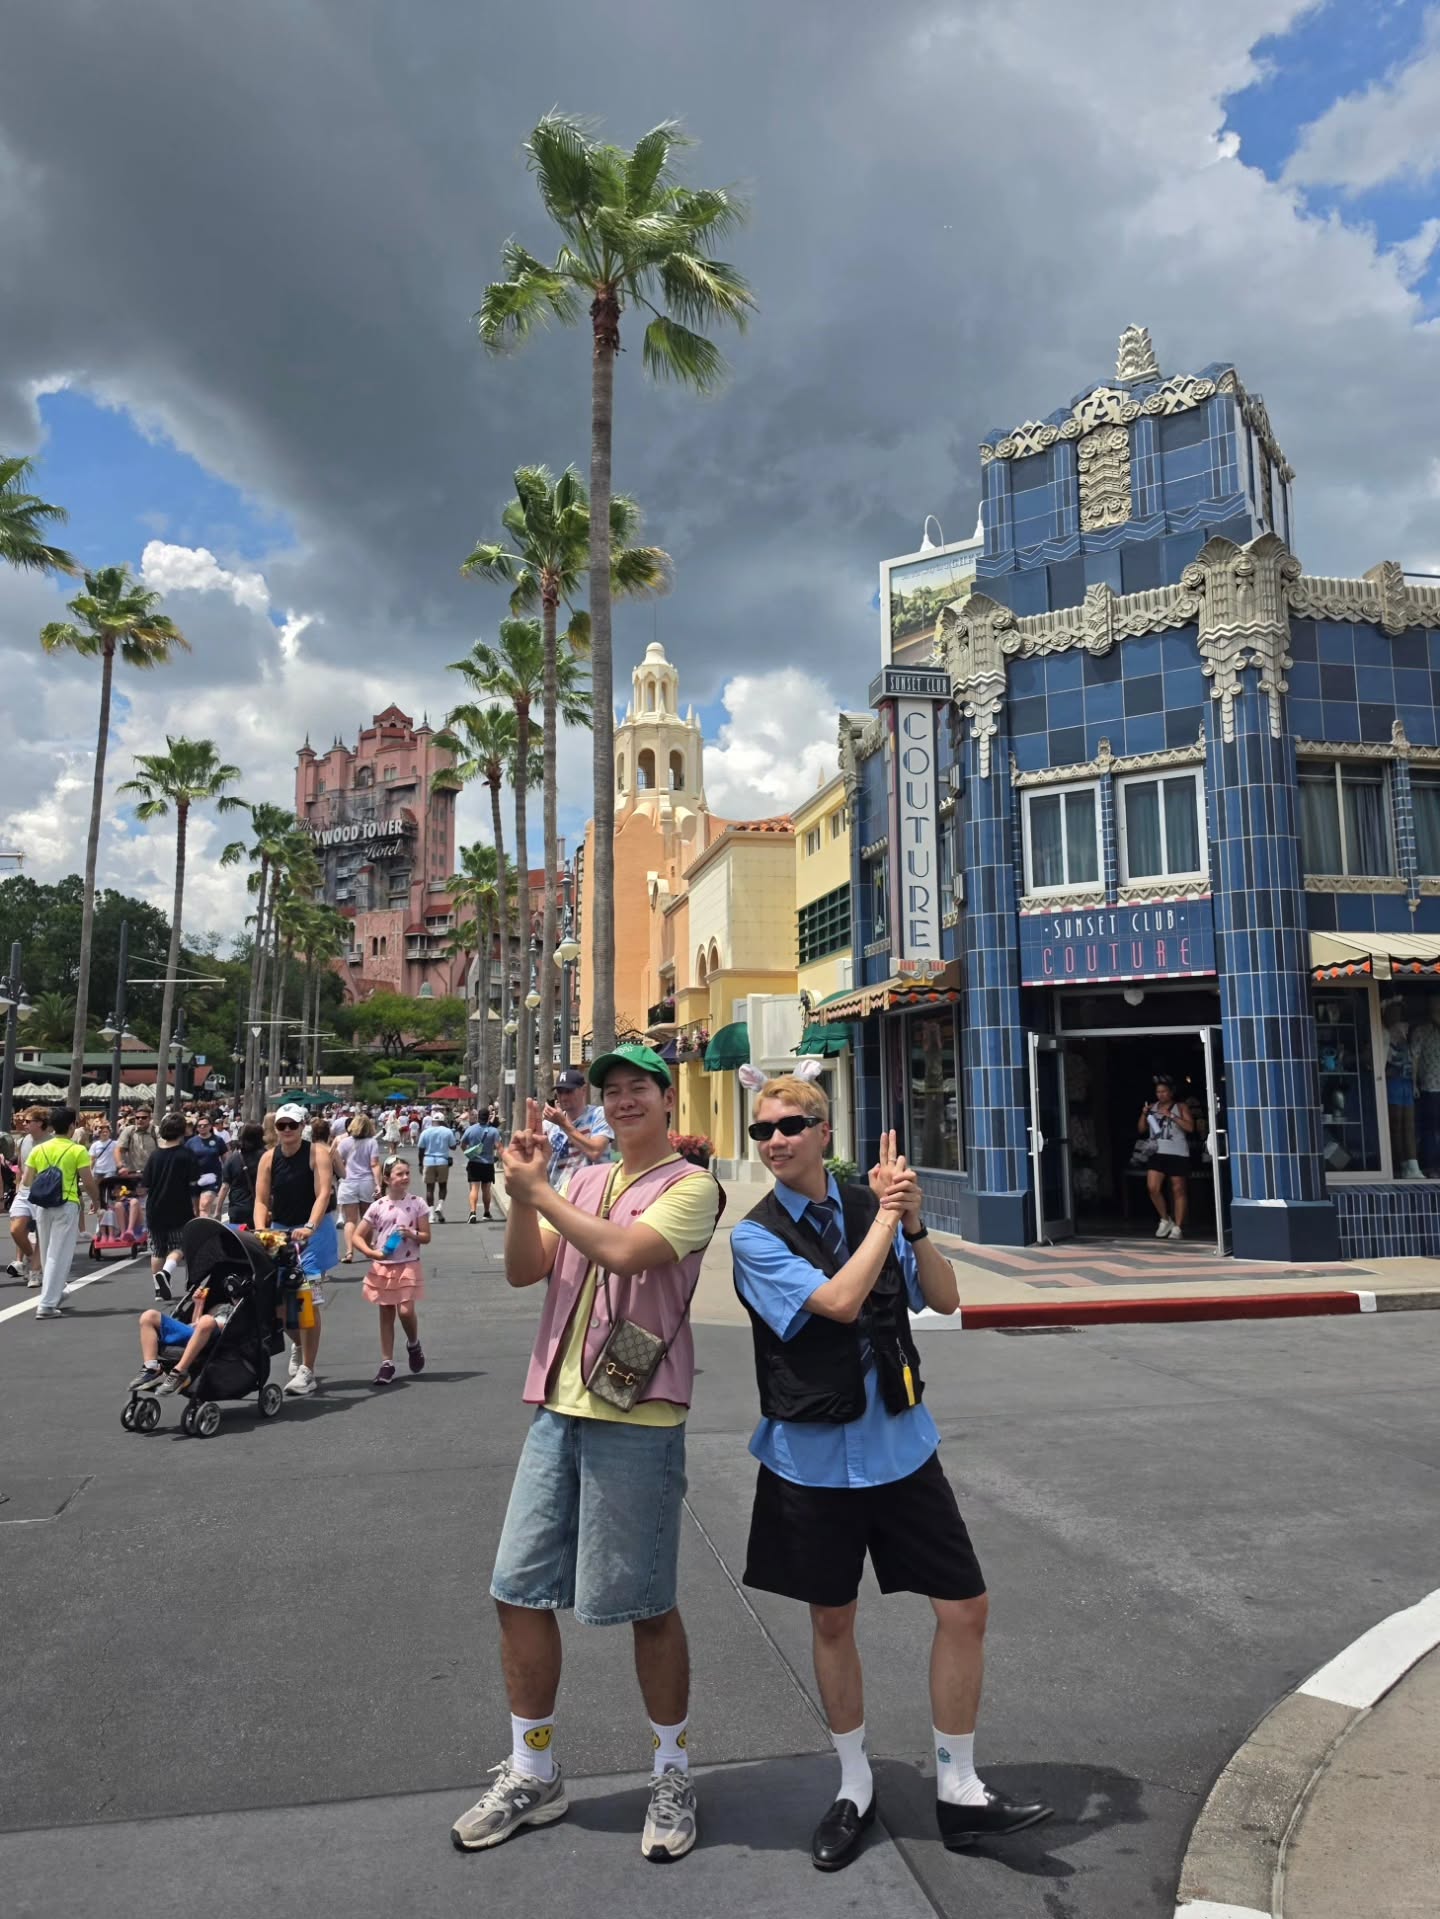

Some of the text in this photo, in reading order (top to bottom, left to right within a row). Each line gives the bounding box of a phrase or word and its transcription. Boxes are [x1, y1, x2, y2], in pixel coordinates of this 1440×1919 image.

[890, 675, 947, 692] SUNSET CLUB
[362, 819, 403, 839] TOWER
[903, 712, 931, 947] COUTURE
[365, 838, 401, 859] Hotel
[1054, 909, 1175, 939] SUNSET CLUB
[1043, 937, 1190, 975] COUTURE
[513, 1793, 531, 1809] N
